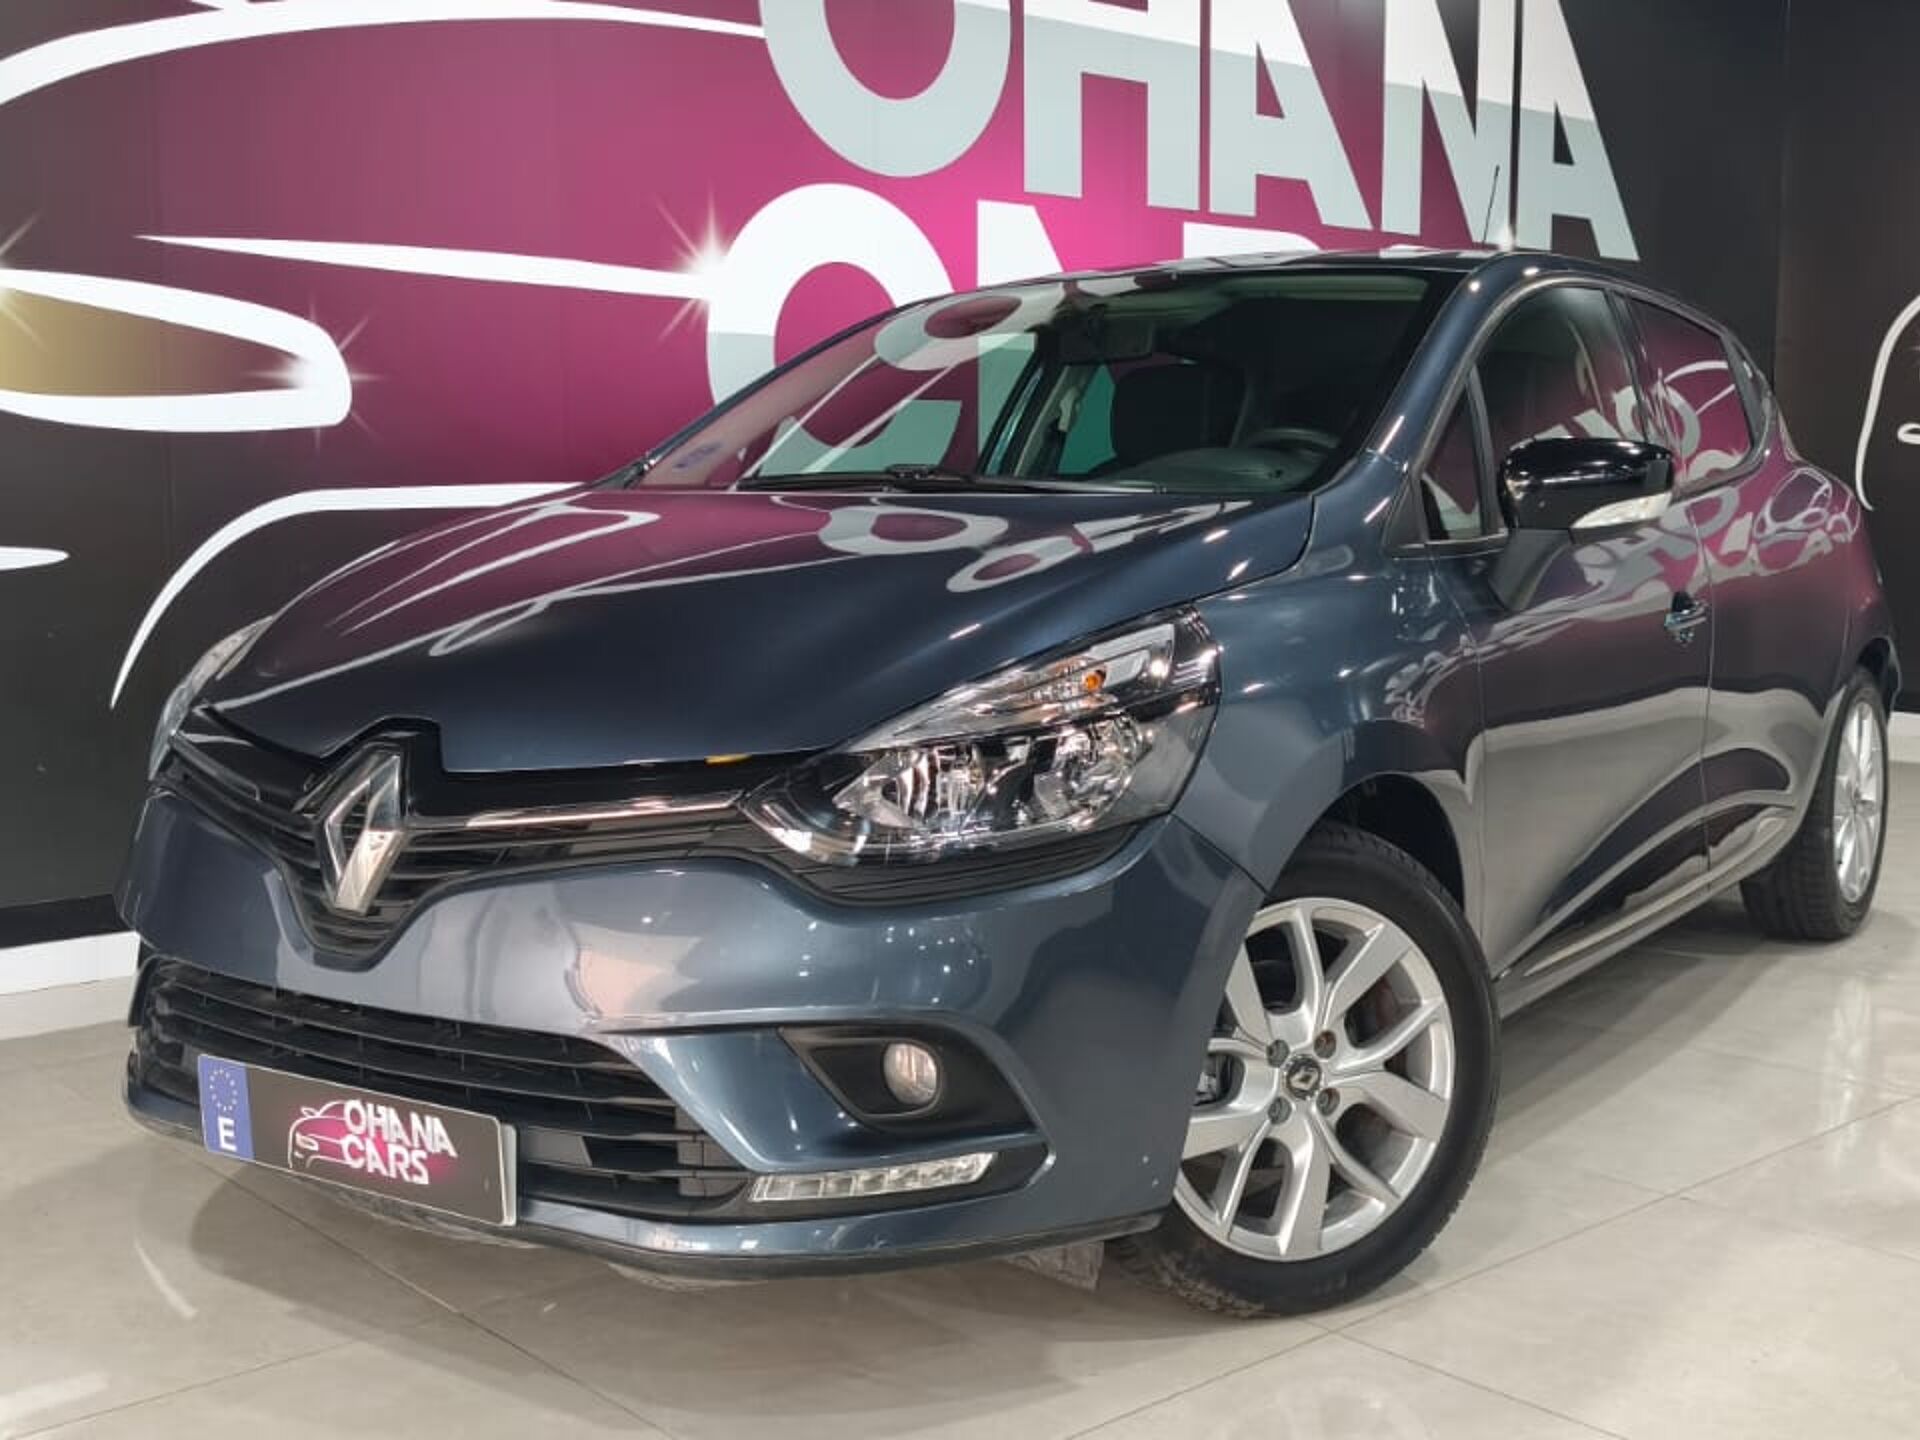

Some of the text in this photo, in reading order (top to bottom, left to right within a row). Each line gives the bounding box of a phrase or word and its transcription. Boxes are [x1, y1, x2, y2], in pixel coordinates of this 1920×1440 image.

[217, 1116, 238, 1152] E
[344, 1099, 458, 1158] OHANA
[343, 1134, 430, 1184] CARS
